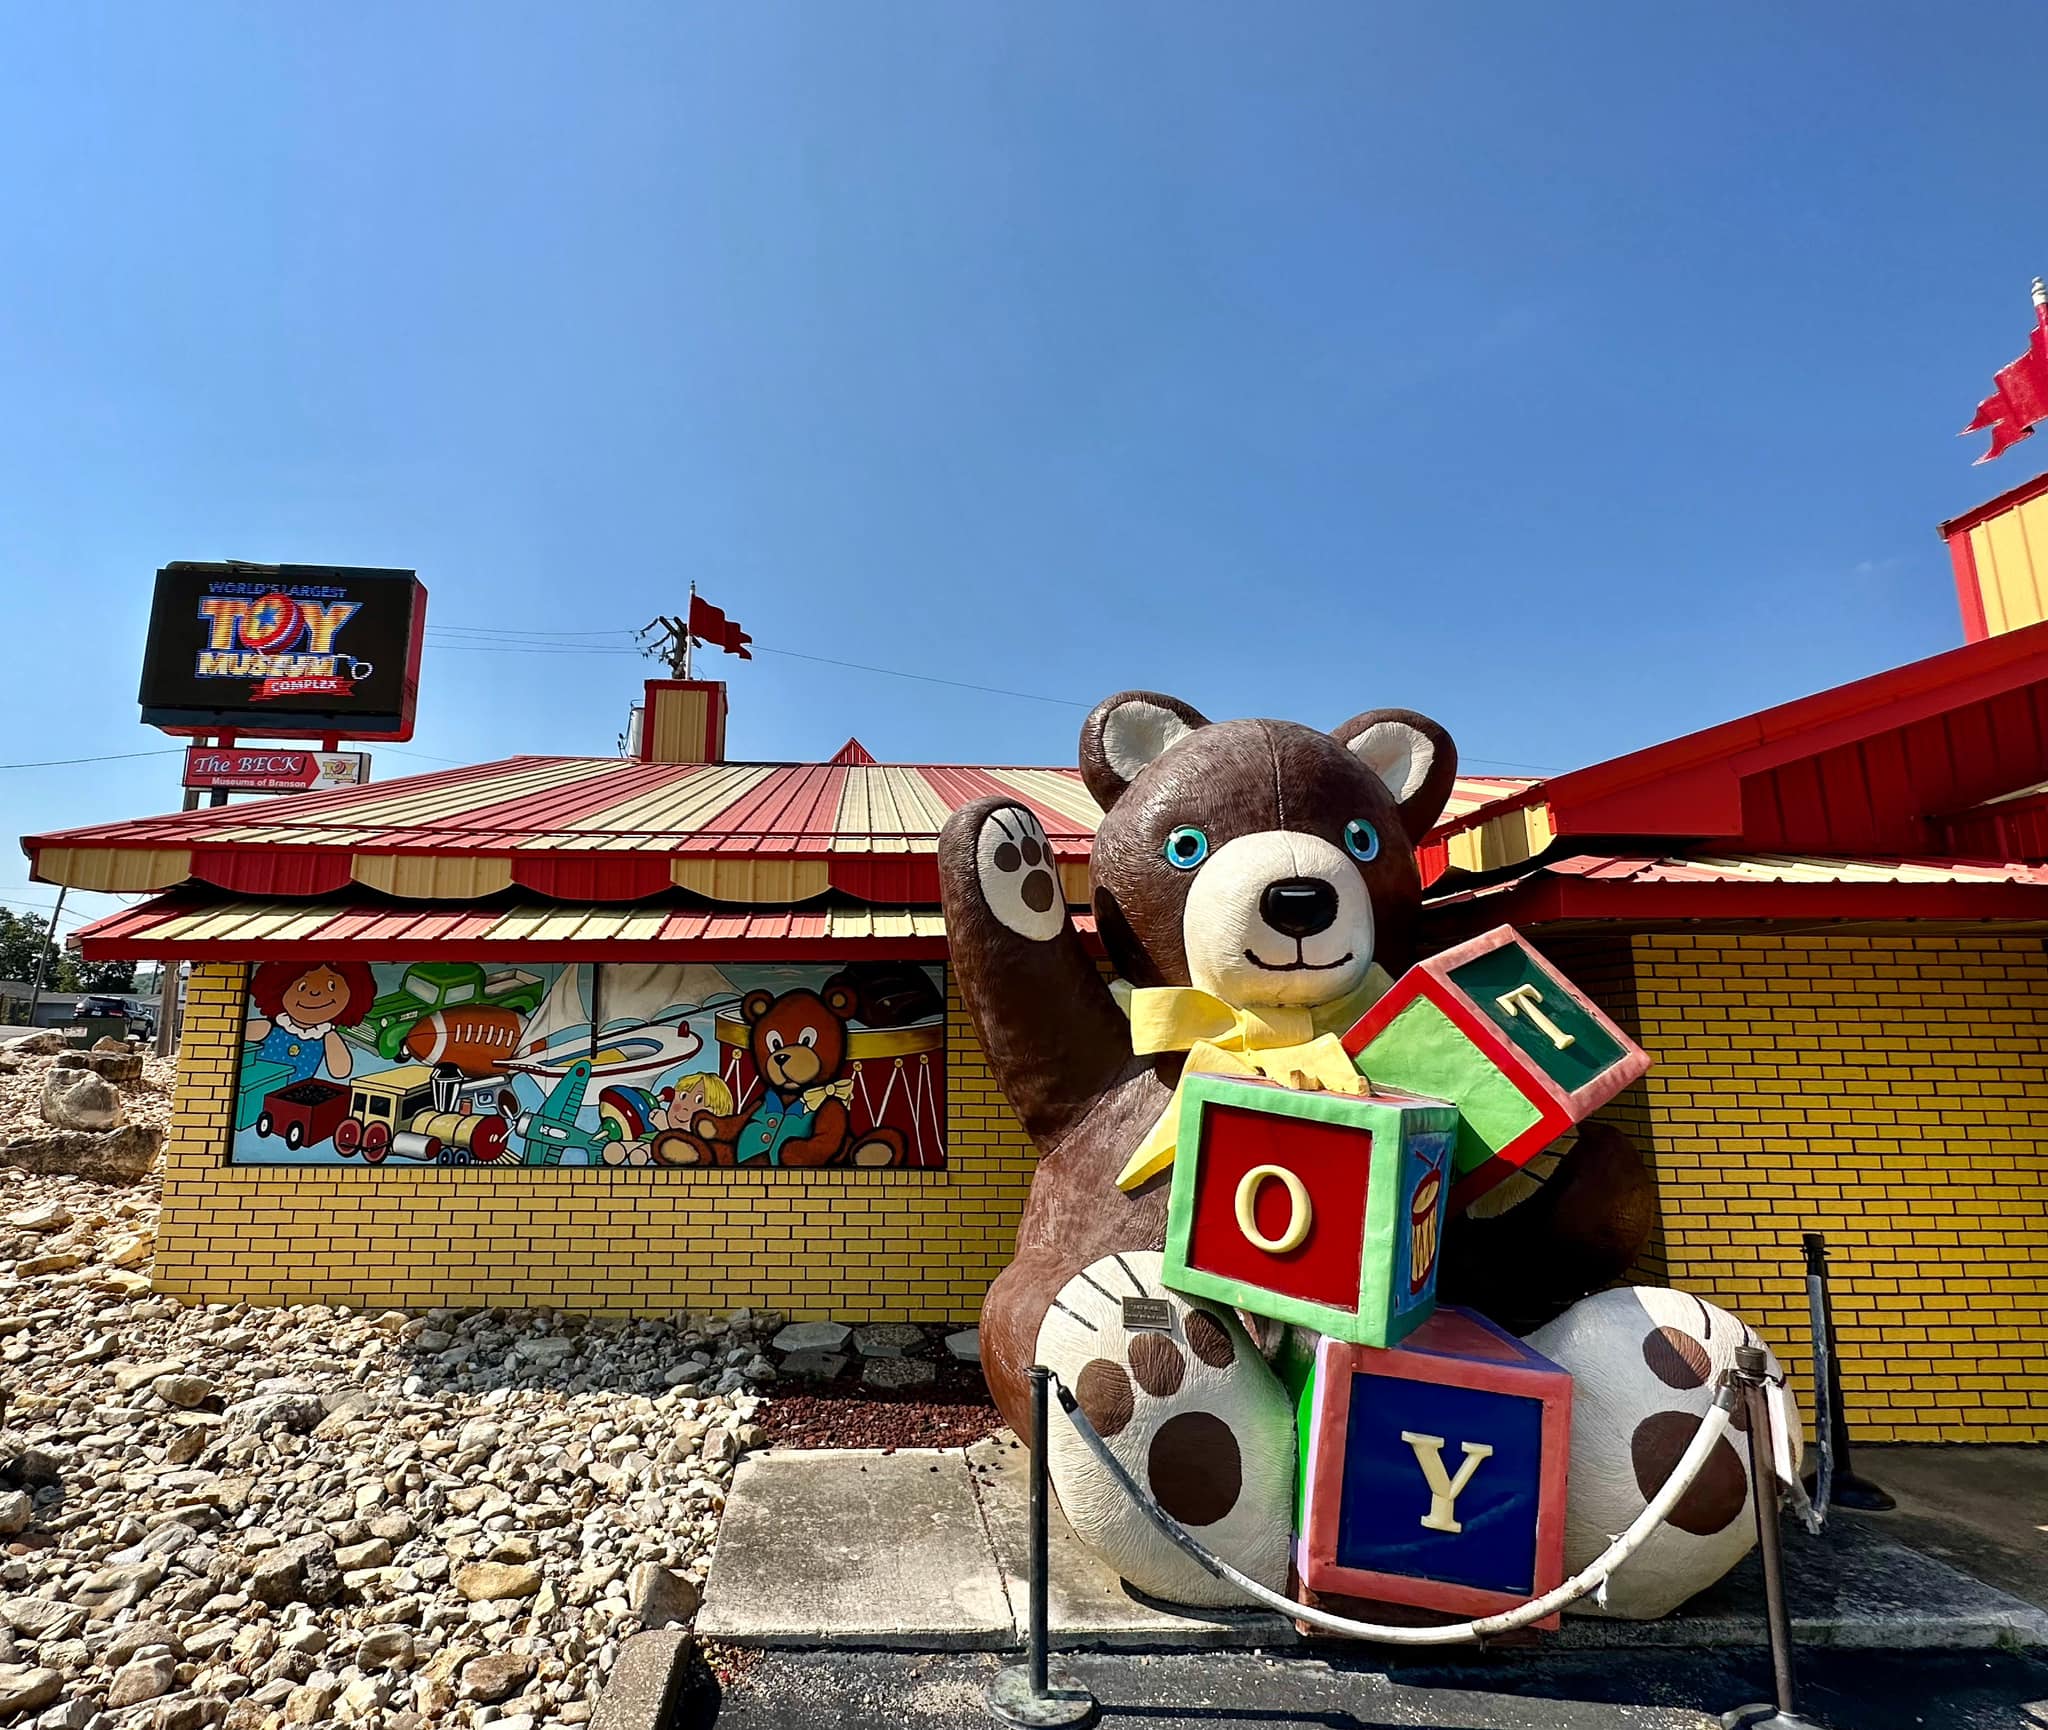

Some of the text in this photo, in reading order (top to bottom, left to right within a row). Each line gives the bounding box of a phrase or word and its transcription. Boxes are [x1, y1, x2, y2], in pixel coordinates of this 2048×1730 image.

[208, 582, 347, 598] WORLD'S LARGEST
[198, 592, 361, 655] TOY
[196, 651, 338, 678] MUSEUM
[271, 679, 337, 692] COMPLEX
[194, 755, 299, 773] The BECK
[212, 777, 306, 788] Museums of Branson
[1495, 983, 1575, 1051] T
[1234, 1163, 1312, 1254] O
[1401, 1430, 1493, 1534] Y
